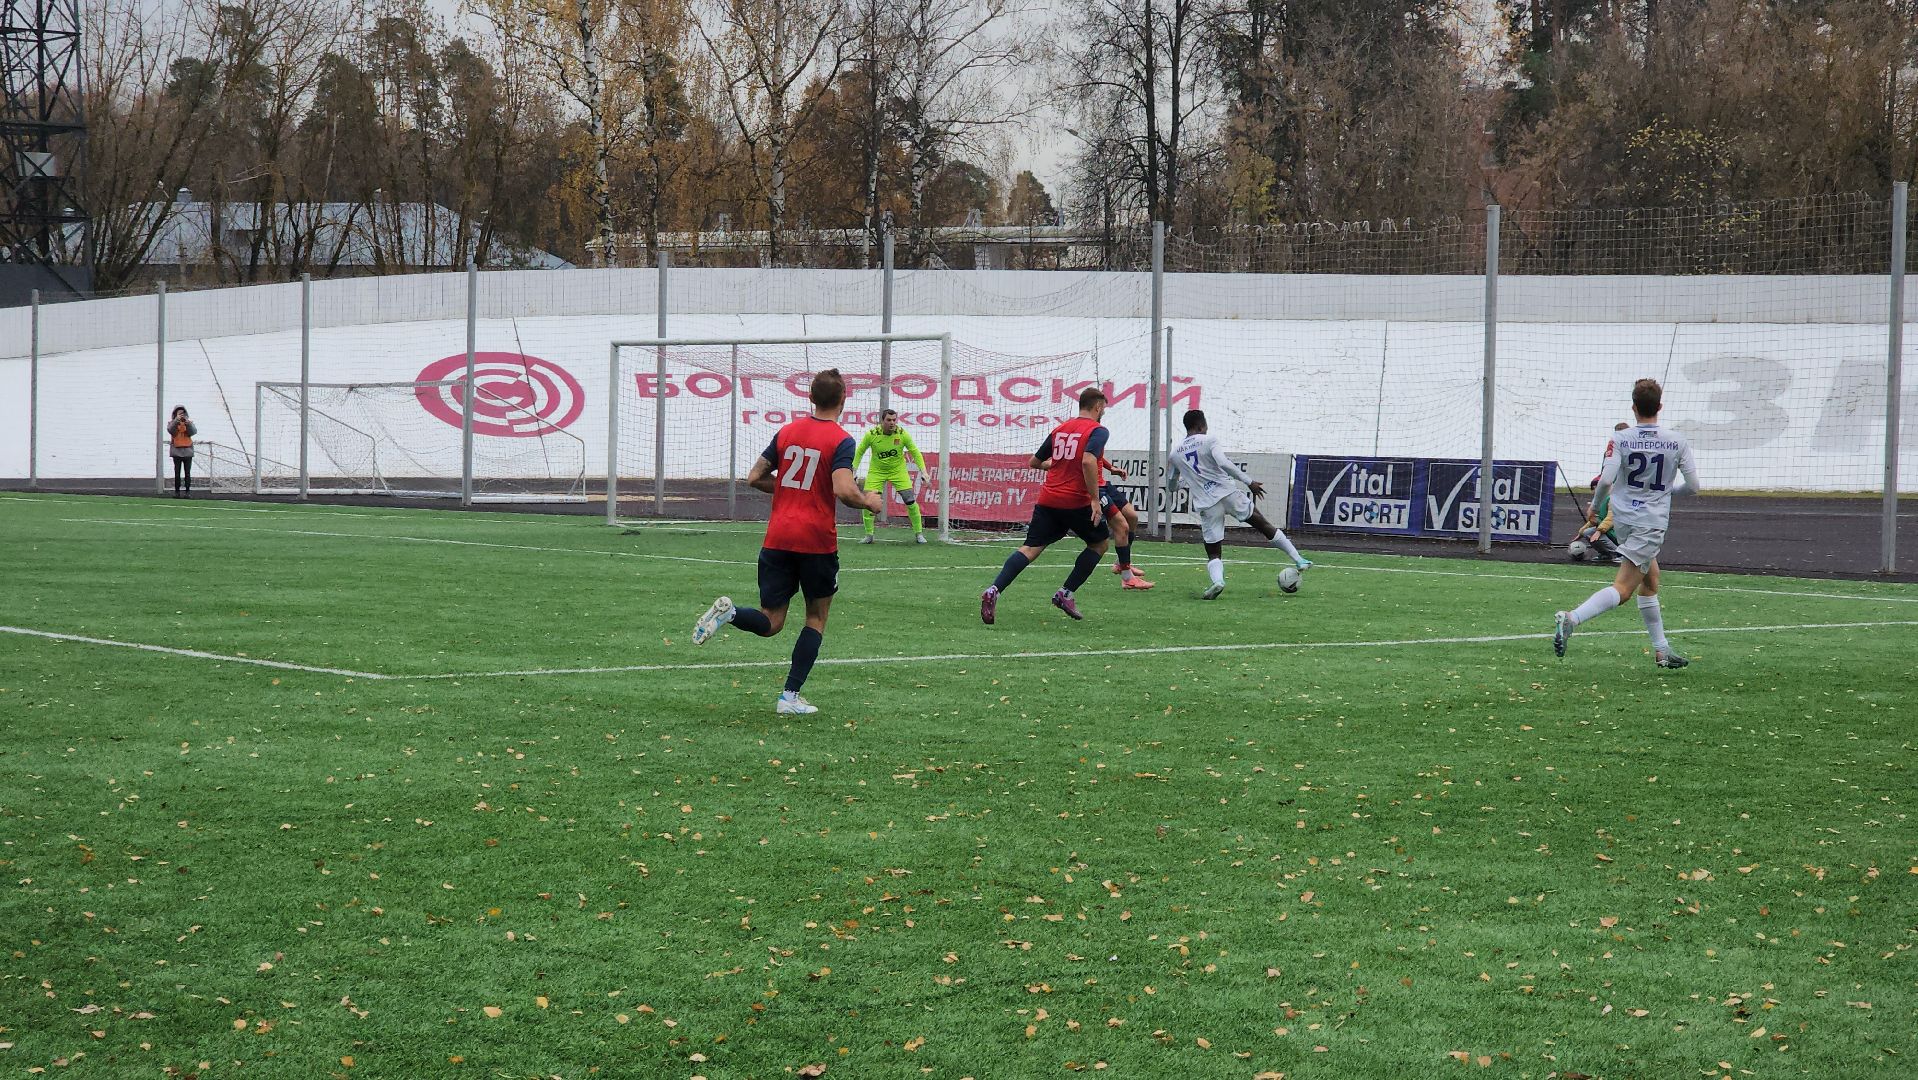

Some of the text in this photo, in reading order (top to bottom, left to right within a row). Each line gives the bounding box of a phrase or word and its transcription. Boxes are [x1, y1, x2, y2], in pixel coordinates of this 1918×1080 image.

[742, 409, 966, 427] ГОРДСКОЙ
[1052, 432, 1082, 460] 55
[1619, 439, 1679, 451] КАШПЕРСКИЙ
[780, 444, 821, 491] 27
[1184, 450, 1202, 474] 7
[1627, 452, 1666, 492] 21
[948, 487, 1003, 509] Znamya
[1006, 487, 1029, 506] TV
[1337, 500, 1408, 526] SPORT
